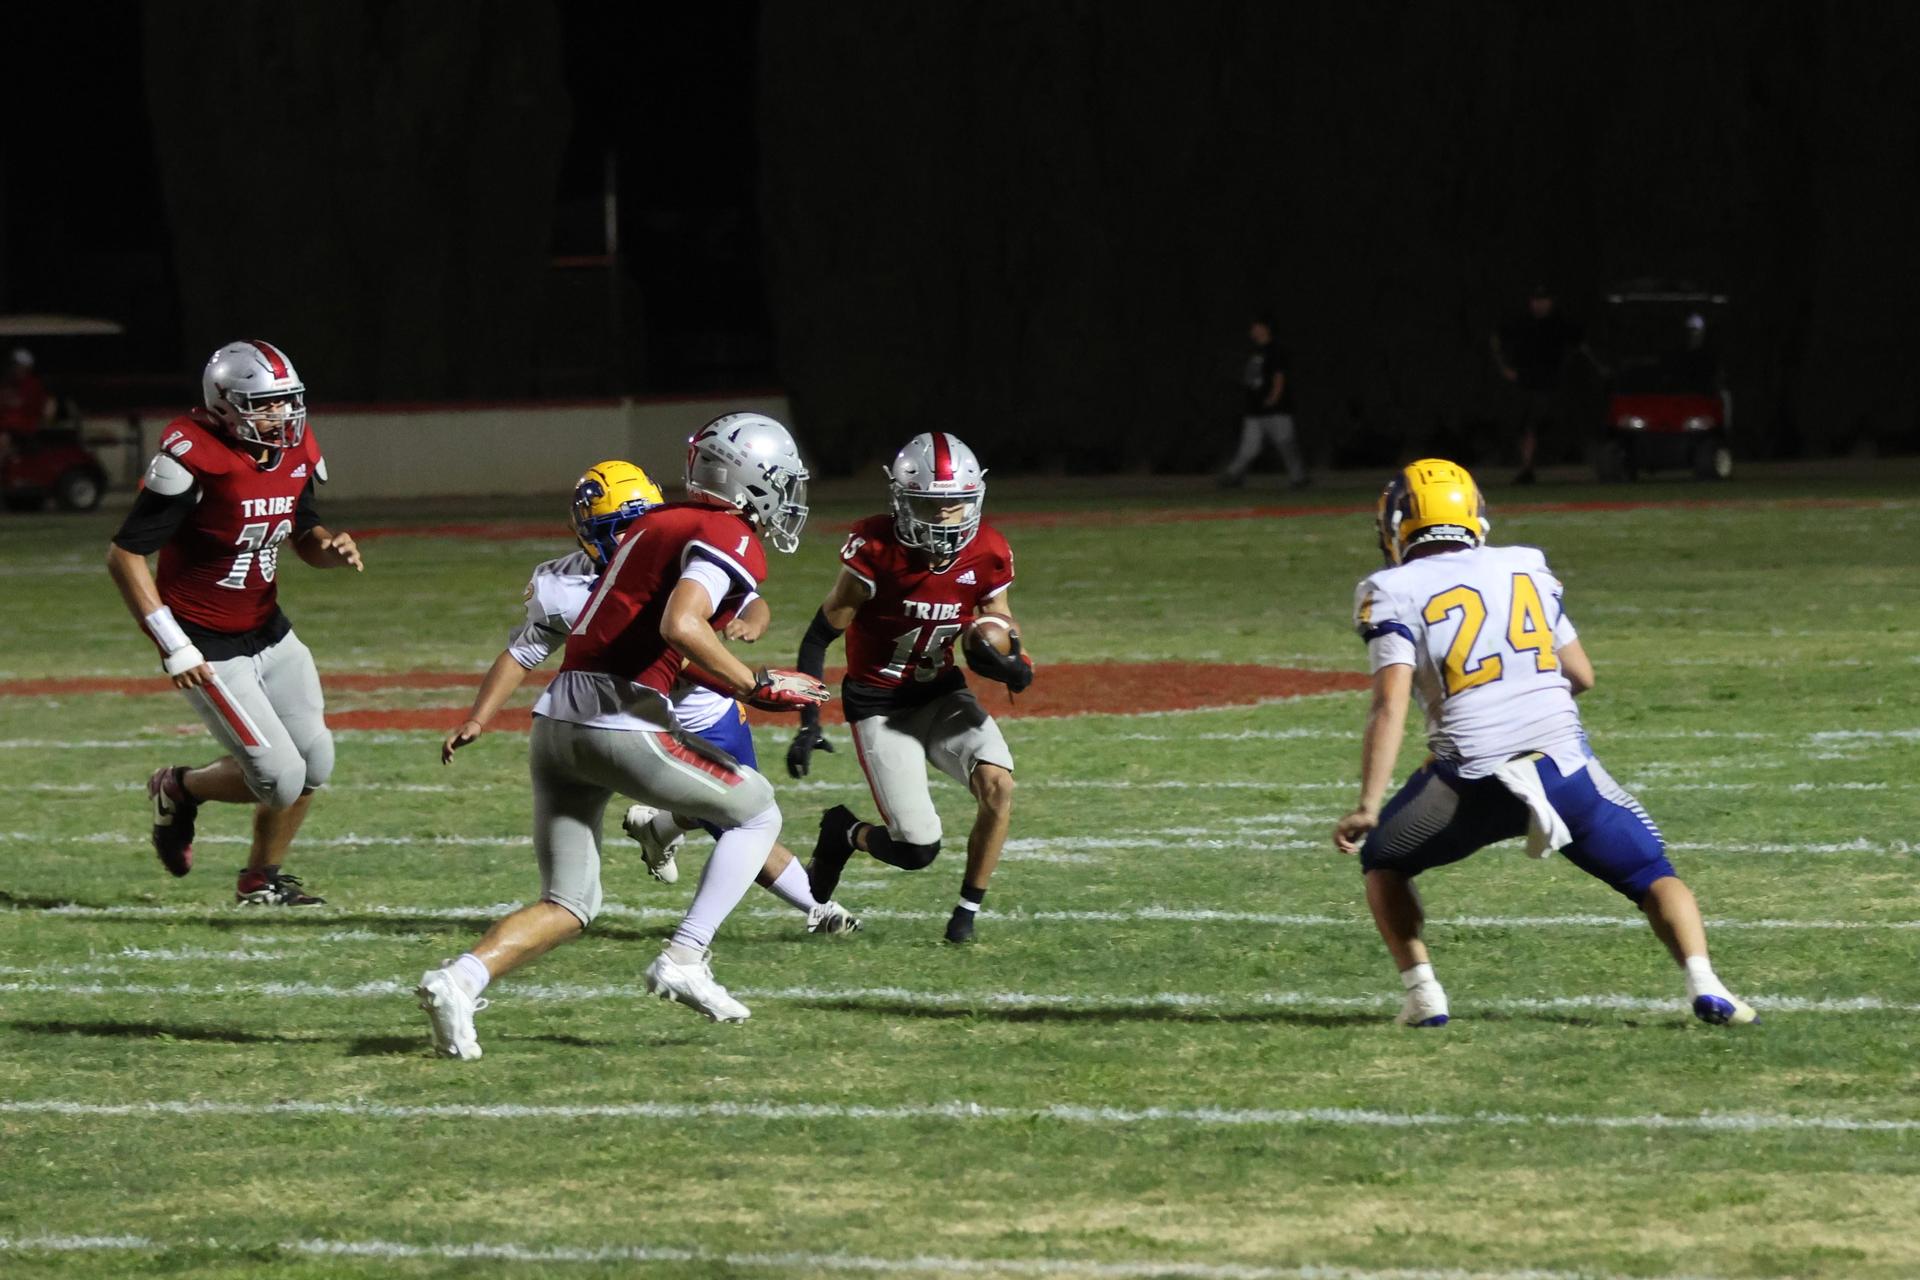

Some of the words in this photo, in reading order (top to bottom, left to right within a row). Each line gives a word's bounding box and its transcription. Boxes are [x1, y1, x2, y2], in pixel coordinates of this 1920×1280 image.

[241, 496, 296, 519] TRIBE
[216, 518, 293, 590] 70
[734, 535, 750, 558] 1
[571, 528, 647, 636] 1
[902, 599, 962, 621] TRIBE
[878, 623, 962, 683] 15
[1421, 571, 1560, 698] 24
